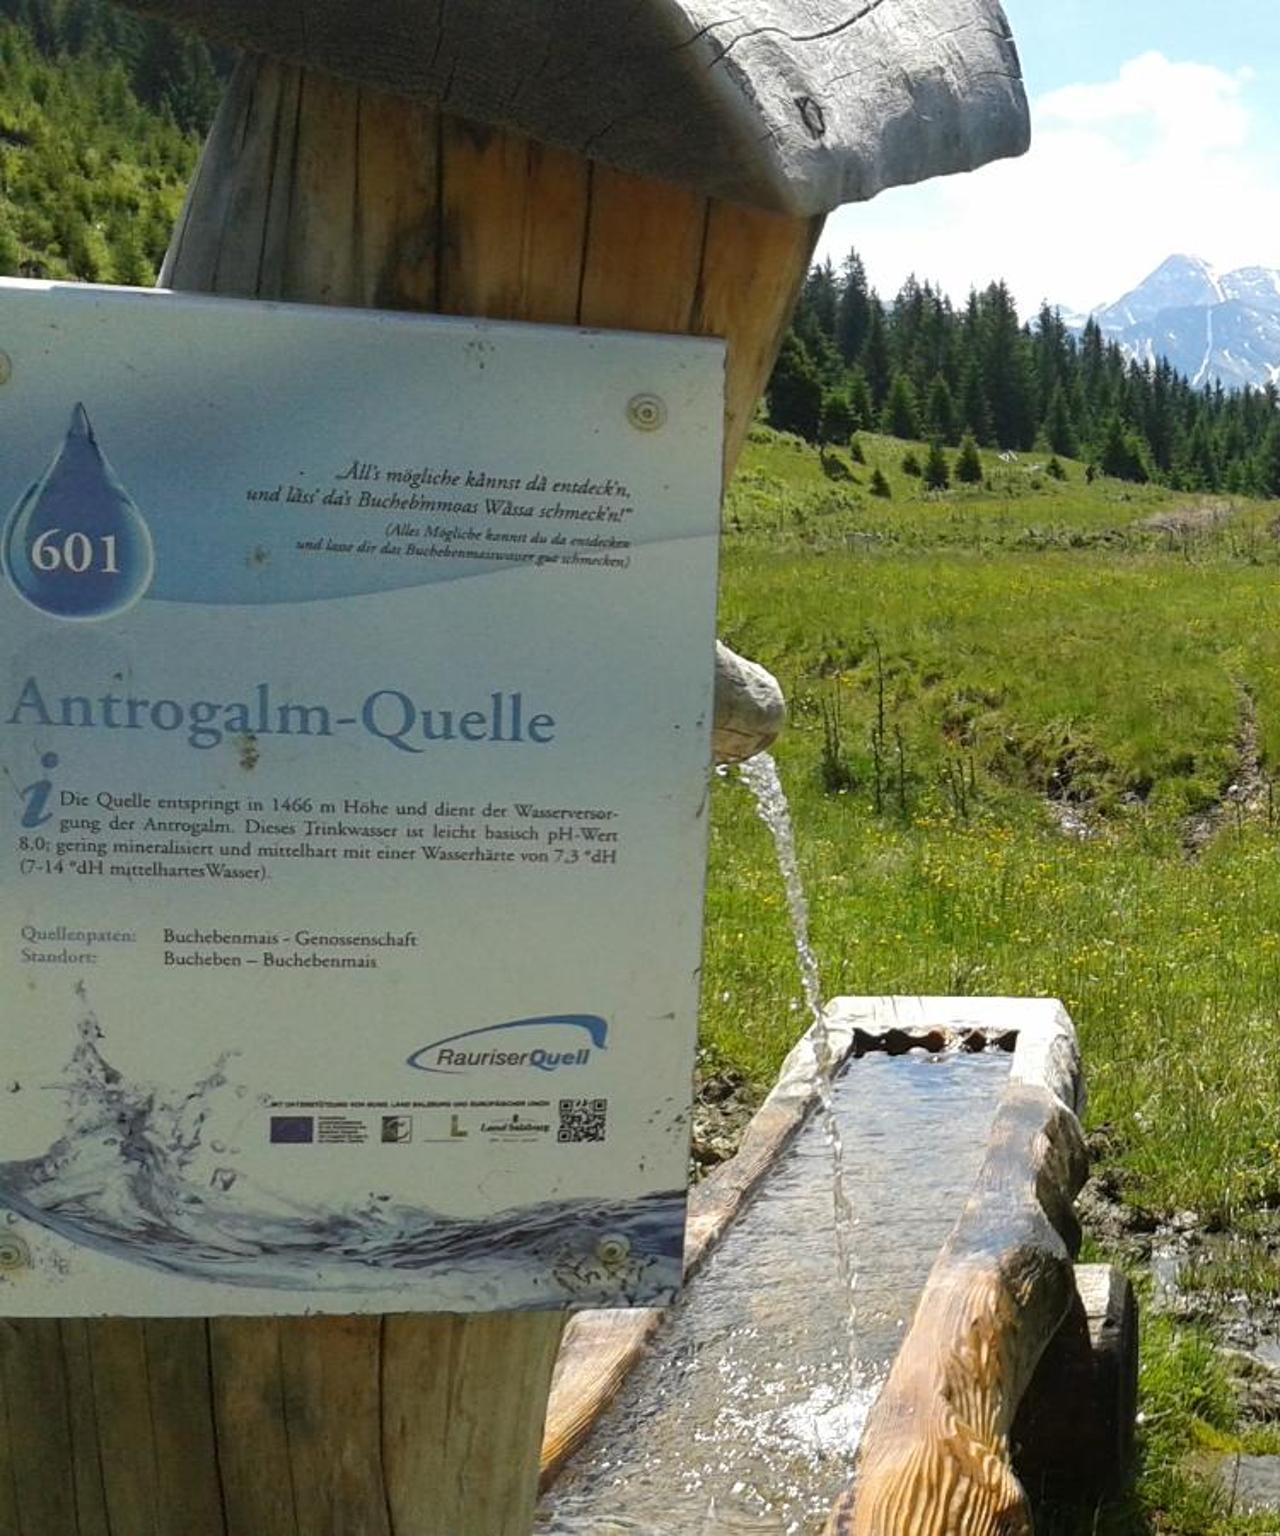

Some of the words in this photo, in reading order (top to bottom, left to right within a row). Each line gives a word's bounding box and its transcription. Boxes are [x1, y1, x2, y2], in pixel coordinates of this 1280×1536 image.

[386, 467, 459, 488] mögliche
[246, 486, 282, 502] und
[296, 538, 323, 550] und
[530, 532, 548, 545] du
[31, 528, 120, 573] 601
[5, 676, 557, 753] Antrogalm-Quelle
[60, 790, 89, 807] Die
[97, 791, 152, 811] Quelle
[158, 796, 241, 815] entspringt
[249, 797, 263, 812] in
[272, 797, 313, 813] 1466
[320, 802, 335, 814] m
[344, 799, 389, 815] Höhe
[396, 800, 427, 816] und
[434, 802, 475, 818] dient
[482, 802, 508, 818] der
[514, 804, 619, 820] Wasserversor-
[60, 818, 101, 834] gung
[109, 816, 134, 831] der
[143, 817, 235, 836] Antrogalm.
[245, 819, 296, 836] Dieses
[304, 820, 397, 838] Trinkwasser
[406, 823, 424, 838] ist
[433, 824, 476, 840] leicht
[485, 824, 539, 841] basisch
[548, 826, 618, 845] pH-Wert
[56, 839, 108, 857] gering
[113, 839, 214, 856] mineralisiert
[219, 842, 251, 857] und
[257, 843, 337, 859] mittelhart
[343, 845, 371, 860] mit
[377, 847, 416, 861] einer
[422, 846, 516, 862] Wasserhärte
[521, 851, 549, 863] von
[20, 858, 63, 875] (7-14
[21, 926, 136, 946] Quellenpaten:
[163, 928, 279, 945] Buchebenmais
[295, 931, 418, 947] Genossenschaft
[21, 948, 97, 964] Standort:
[164, 951, 241, 967] Bucheben
[263, 952, 378, 968] Buchebenmais
[437, 1049, 591, 1071] RauriserQuell
